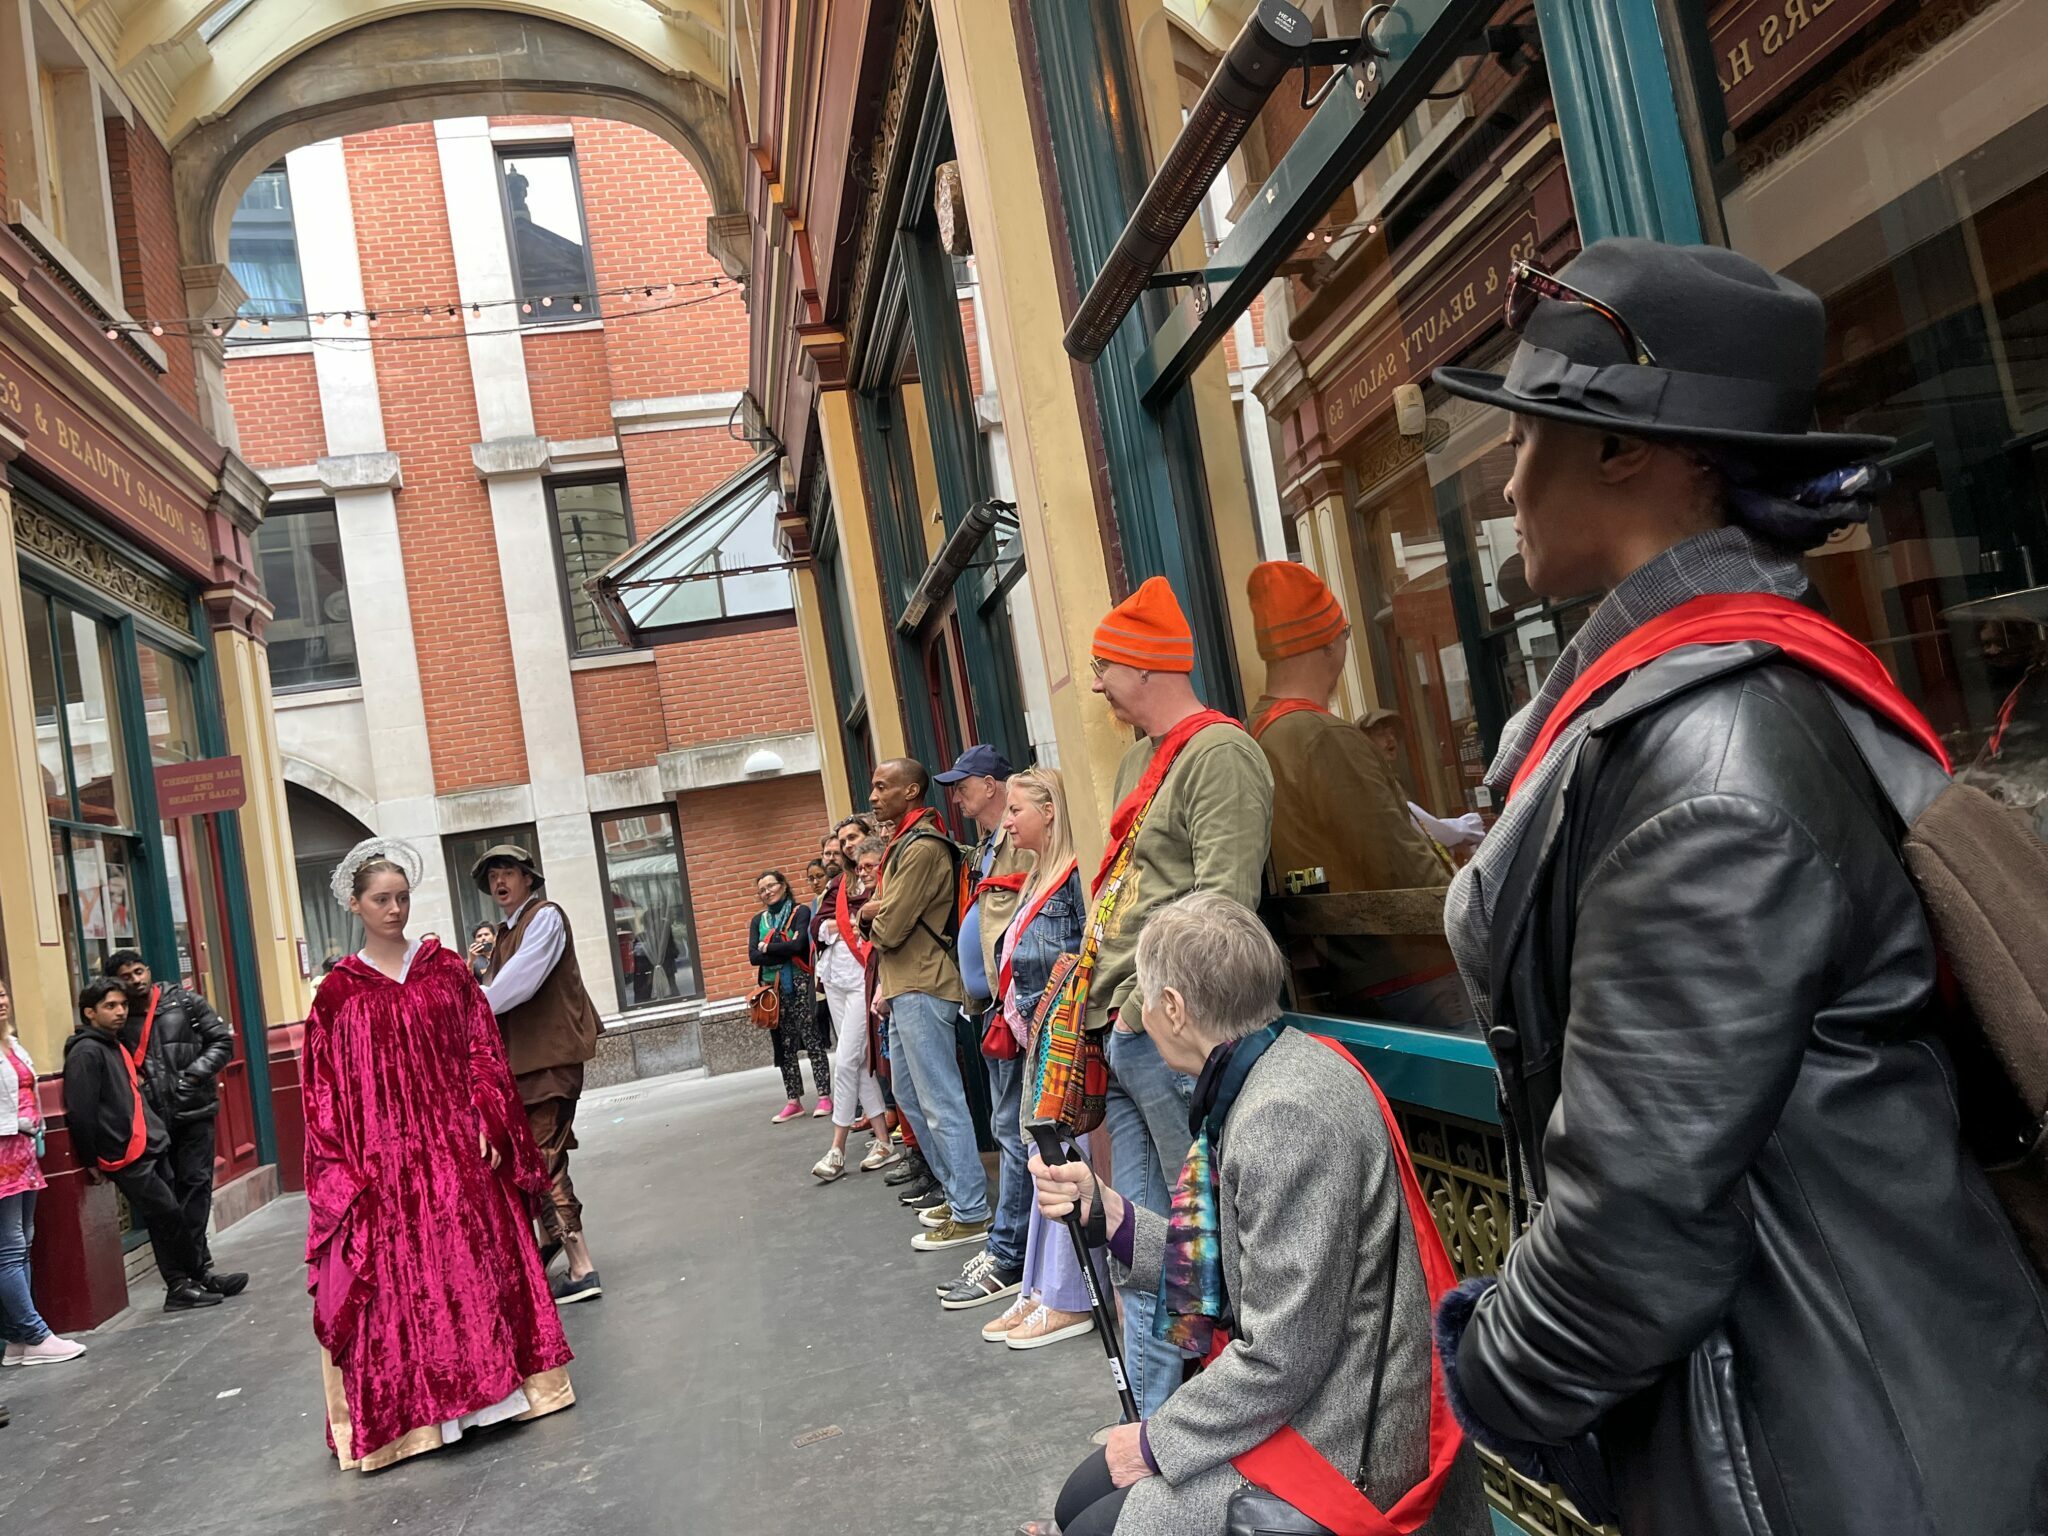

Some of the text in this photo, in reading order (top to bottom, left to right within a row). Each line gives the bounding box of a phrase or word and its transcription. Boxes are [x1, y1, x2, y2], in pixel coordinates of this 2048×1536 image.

[1278, 11, 1297, 26] HEAT
[35, 403, 48, 435] &
[56, 418, 131, 496] BEAUTY
[137, 481, 185, 536] SALON
[190, 521, 207, 551] 53
[216, 769, 241, 780] HAIR
[193, 783, 214, 793] AND
[169, 788, 240, 805] BEAUTY SALON
